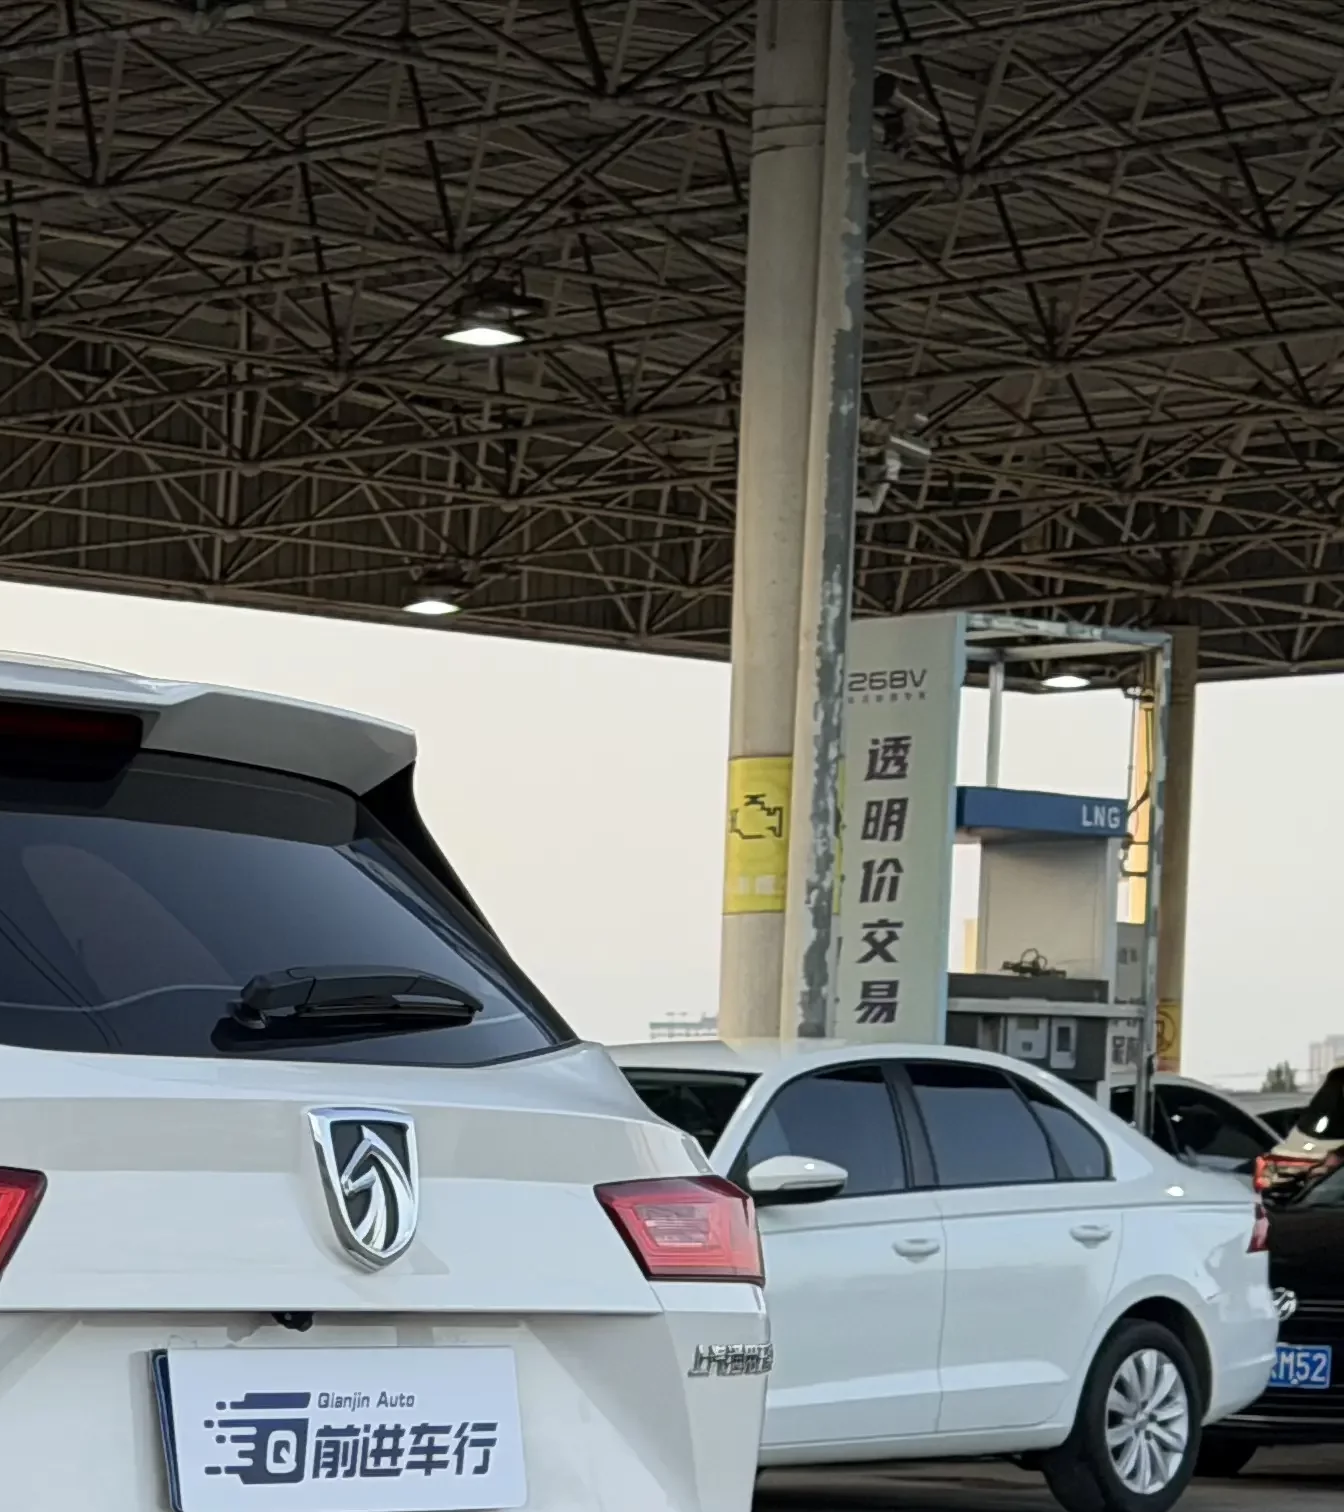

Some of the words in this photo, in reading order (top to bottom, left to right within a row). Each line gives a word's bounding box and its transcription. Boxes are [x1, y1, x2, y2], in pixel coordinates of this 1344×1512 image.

[848, 669, 927, 692] 268V
[1082, 804, 1121, 829] LNG
[855, 735, 912, 1024] 透明价交易
[1271, 1351, 1328, 1383] M52
[317, 1392, 370, 1412] Qianjin
[376, 1391, 415, 1408] Auto
[312, 1422, 498, 1479] 前进车行
